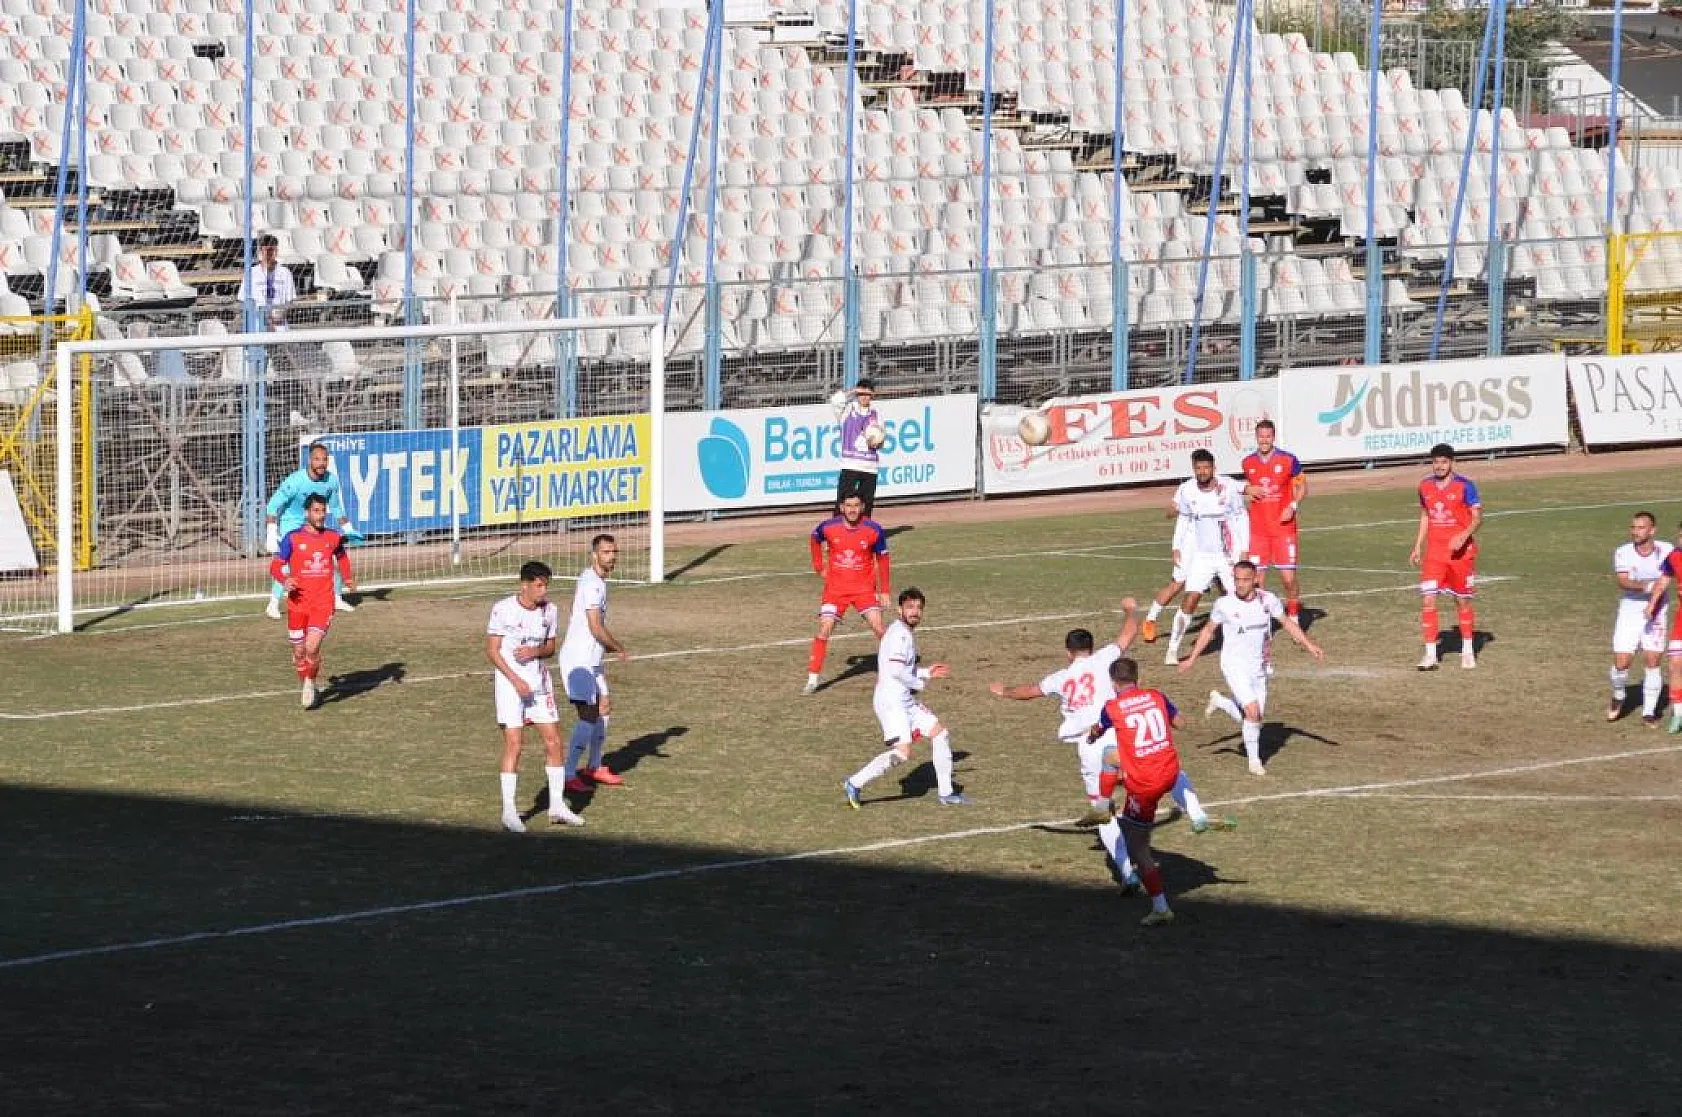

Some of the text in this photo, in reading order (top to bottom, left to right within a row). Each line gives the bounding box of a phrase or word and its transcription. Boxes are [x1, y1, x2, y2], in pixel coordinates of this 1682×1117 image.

[1043, 390, 1223, 446] FES
[1326, 370, 1533, 437] Address
[497, 423, 638, 467] PAZARLAMA
[764, 405, 934, 462] Barasel
[1364, 430, 1439, 450] RESTAURANT
[1487, 425, 1512, 441] BAR
[892, 463, 936, 484] GRUP
[1099, 457, 1171, 476] 611 00 24
[491, 467, 643, 513] YAPI MARKET
[1062, 672, 1095, 712] 23
[1125, 708, 1167, 749] 20
